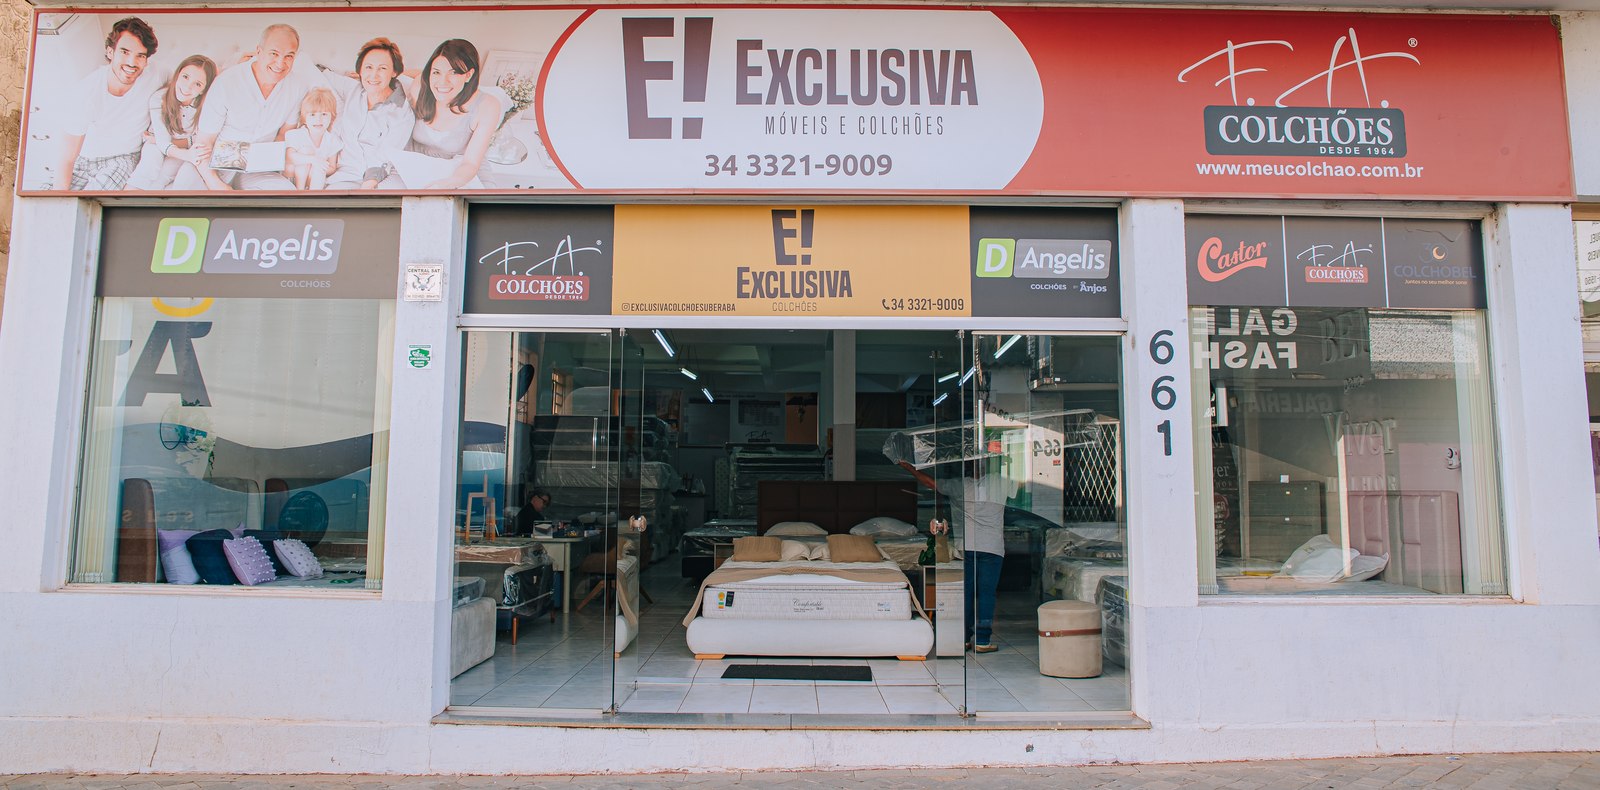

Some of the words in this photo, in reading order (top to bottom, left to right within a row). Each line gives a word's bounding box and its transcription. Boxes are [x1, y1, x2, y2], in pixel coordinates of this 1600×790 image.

[621, 17, 714, 140] E!
[735, 39, 979, 106] EXCLUSIVA
[764, 112, 829, 136] MÓVEIS
[839, 116, 847, 135] E
[858, 113, 944, 136] COLCHÕES
[1218, 109, 1393, 145] COLCHÕES
[1320, 146, 1361, 155] DESDE
[1367, 147, 1395, 155] 1964
[704, 155, 738, 177] 34
[746, 155, 893, 177] 3321-9009
[1196, 160, 1424, 179] www.meucolchao.com.br
[162, 225, 197, 266] D
[213, 224, 334, 269] Angelis
[771, 209, 815, 266] E!
[984, 243, 1007, 272] D
[1021, 243, 1105, 275] Angelis
[1197, 236, 1268, 282] Castor
[280, 279, 331, 288] COLCHÕES
[736, 266, 853, 299] EXCLUSIVA
[1309, 267, 1365, 279] COLCHÕES
[1393, 265, 1477, 279] COLCHOBEL
[496, 276, 583, 295] COLCHÕES
[772, 301, 817, 312] COLCHÕES
[891, 298, 904, 311] 34
[907, 298, 964, 311] 3321-9009
